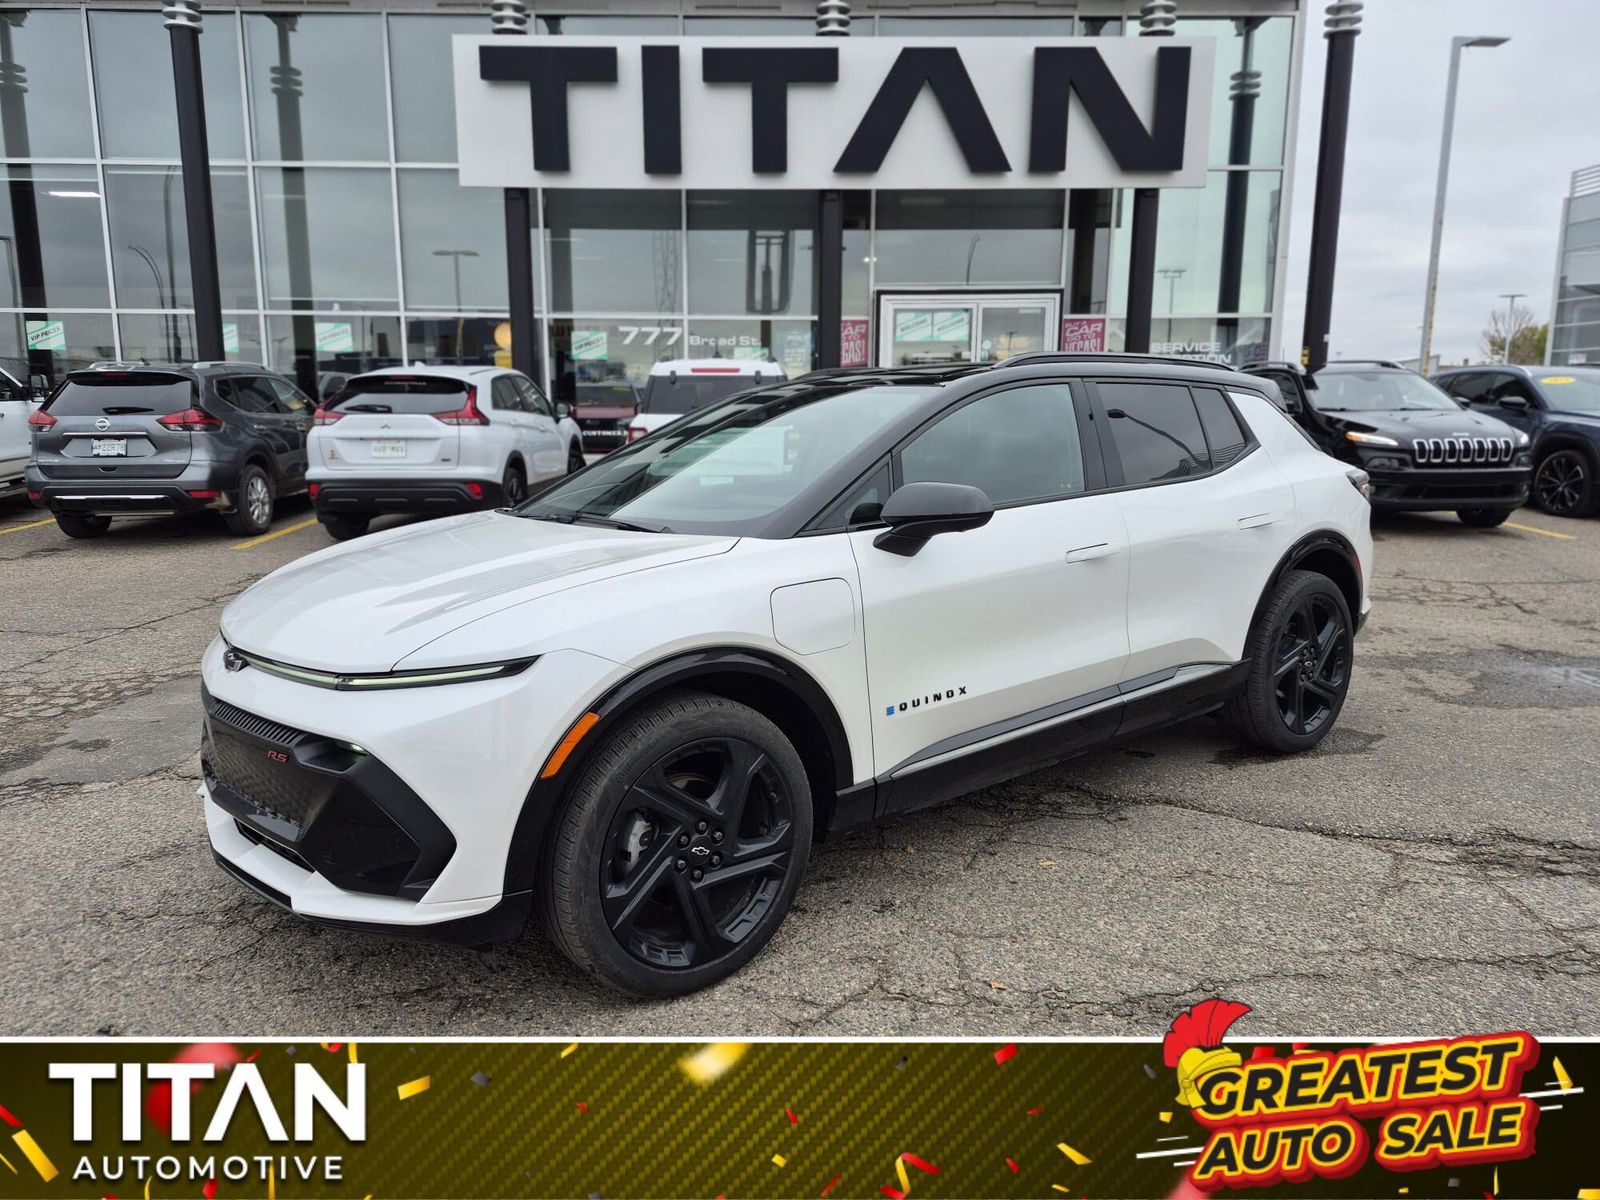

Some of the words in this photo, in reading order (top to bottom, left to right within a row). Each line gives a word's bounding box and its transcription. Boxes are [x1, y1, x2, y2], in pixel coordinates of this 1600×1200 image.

[478, 45, 1192, 174] TITAN
[30, 333, 40, 341] VIP
[40, 326, 60, 338] PRICES
[618, 326, 683, 346] 777
[1066, 323, 1103, 336] CAR
[689, 336, 736, 346] Broad
[740, 336, 762, 346] St.
[1151, 342, 1222, 353] SERVICE
[841, 339, 866, 364] GAS!
[886, 686, 967, 716] EQUINOX
[267, 750, 288, 763] RS
